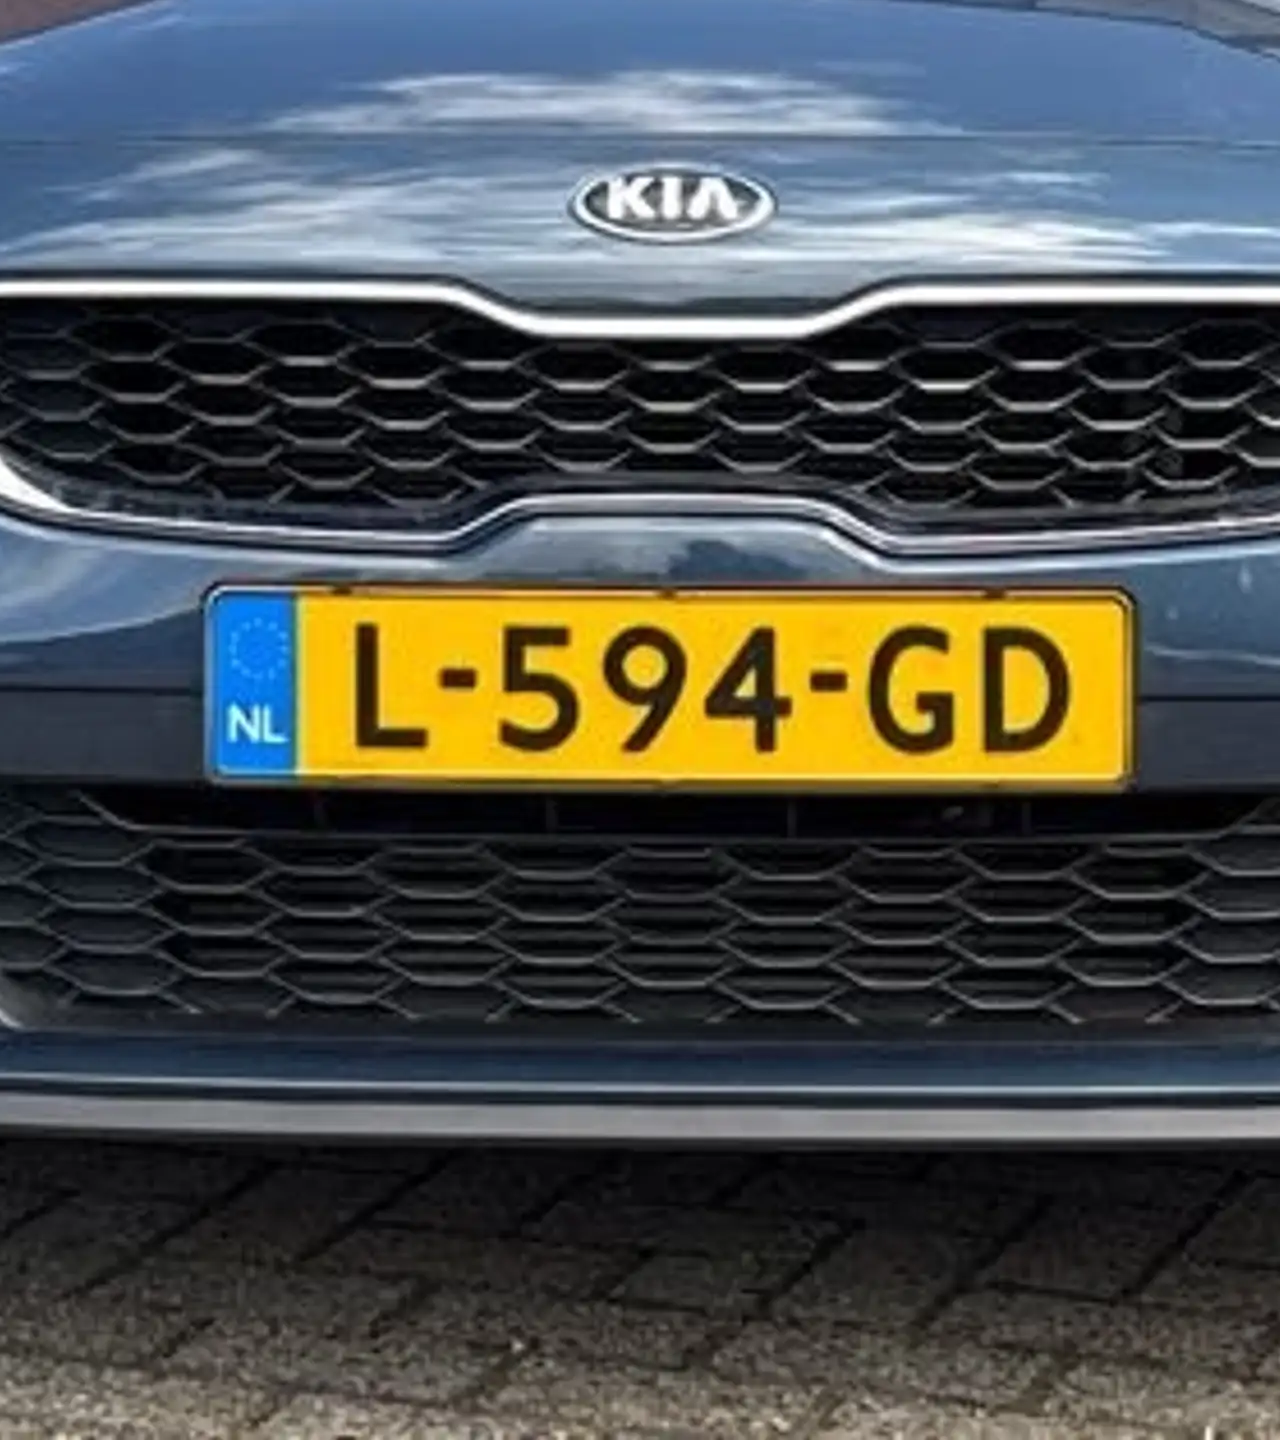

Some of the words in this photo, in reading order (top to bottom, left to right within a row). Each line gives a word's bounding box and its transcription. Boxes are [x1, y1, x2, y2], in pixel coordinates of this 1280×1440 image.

[606, 175, 740, 220] KIA
[227, 703, 287, 745] NL
[354, 623, 1073, 754] L-594-GD
